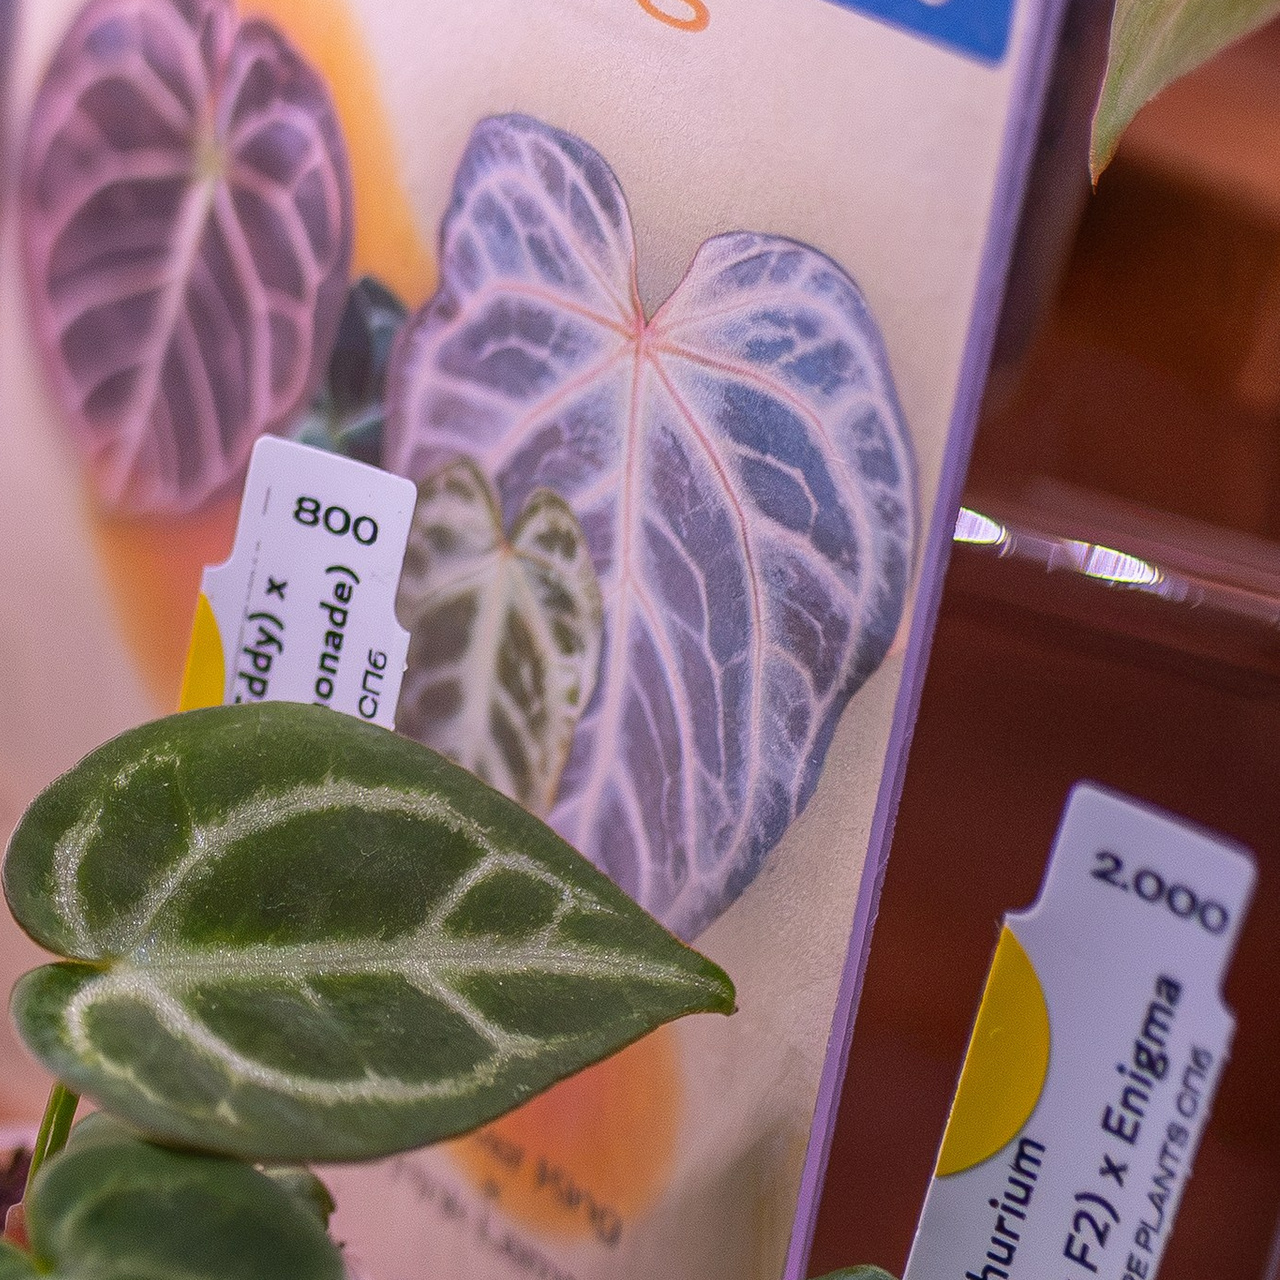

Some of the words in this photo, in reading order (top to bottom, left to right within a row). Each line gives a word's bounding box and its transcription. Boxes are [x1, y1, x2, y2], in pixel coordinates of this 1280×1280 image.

[293, 496, 380, 547] 800
[235, 612, 285, 704] ddy)
[266, 576, 288, 601] x
[314, 565, 361, 706] onade)
[1090, 848, 1230, 937] 2.000
[1100, 973, 1183, 1146] Enigma
[1098, 1152, 1129, 1188] x
[1133, 1121, 1190, 1254] PLANTS
[1063, 1191, 1121, 1274] F2)
